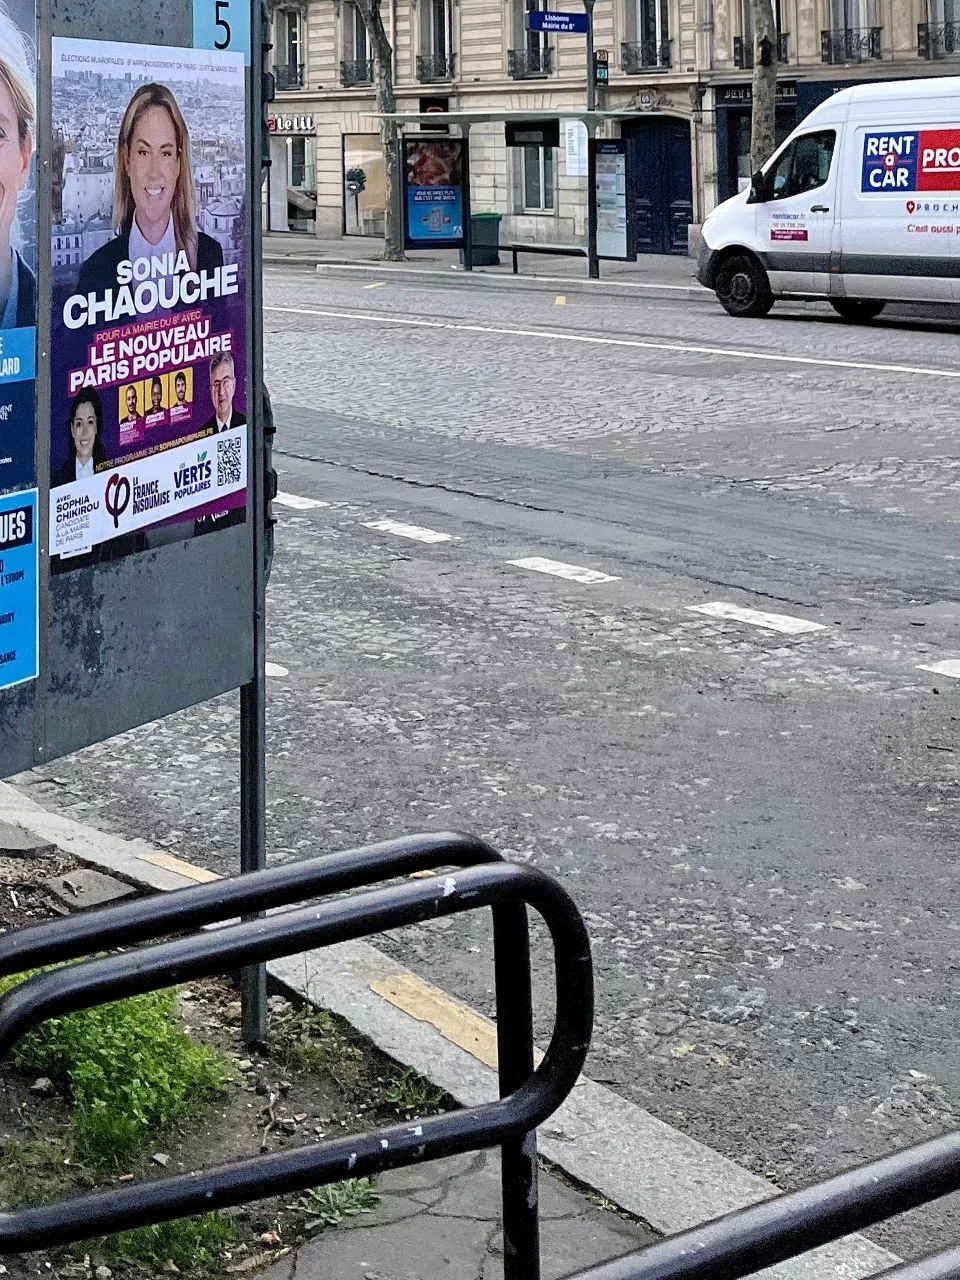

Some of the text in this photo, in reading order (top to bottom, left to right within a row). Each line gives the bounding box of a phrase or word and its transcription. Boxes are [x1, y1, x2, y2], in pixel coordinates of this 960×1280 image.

[214, 0, 231, 50] 5
[542, 22, 560, 30] Mairie
[544, 14, 570, 23] Lisbonne
[866, 135, 915, 156] RENT
[885, 154, 895, 166] a
[869, 168, 909, 188] CAR
[116, 252, 190, 285] SONIA
[62, 263, 239, 330] CHAOUCHE
[96, 319, 171, 342] POUR LA MAIRIE DU
[90, 320, 210, 366] LE NOUVEAU
[70, 333, 232, 392] PARIS POPULAIRE
[114, 448, 149, 466] PROGRAMME
[132, 476, 139, 487] LA
[173, 460, 212, 489] VERTS
[56, 494, 71, 504] AVEC
[132, 480, 159, 503] FRANCE
[173, 479, 211, 501] POPULAIRES
[56, 495, 90, 513] SOPHIA
[56, 500, 100, 523] CHIKIROU
[132, 490, 171, 516] INSOUMISE
[55, 513, 90, 530] CANDIDATE
